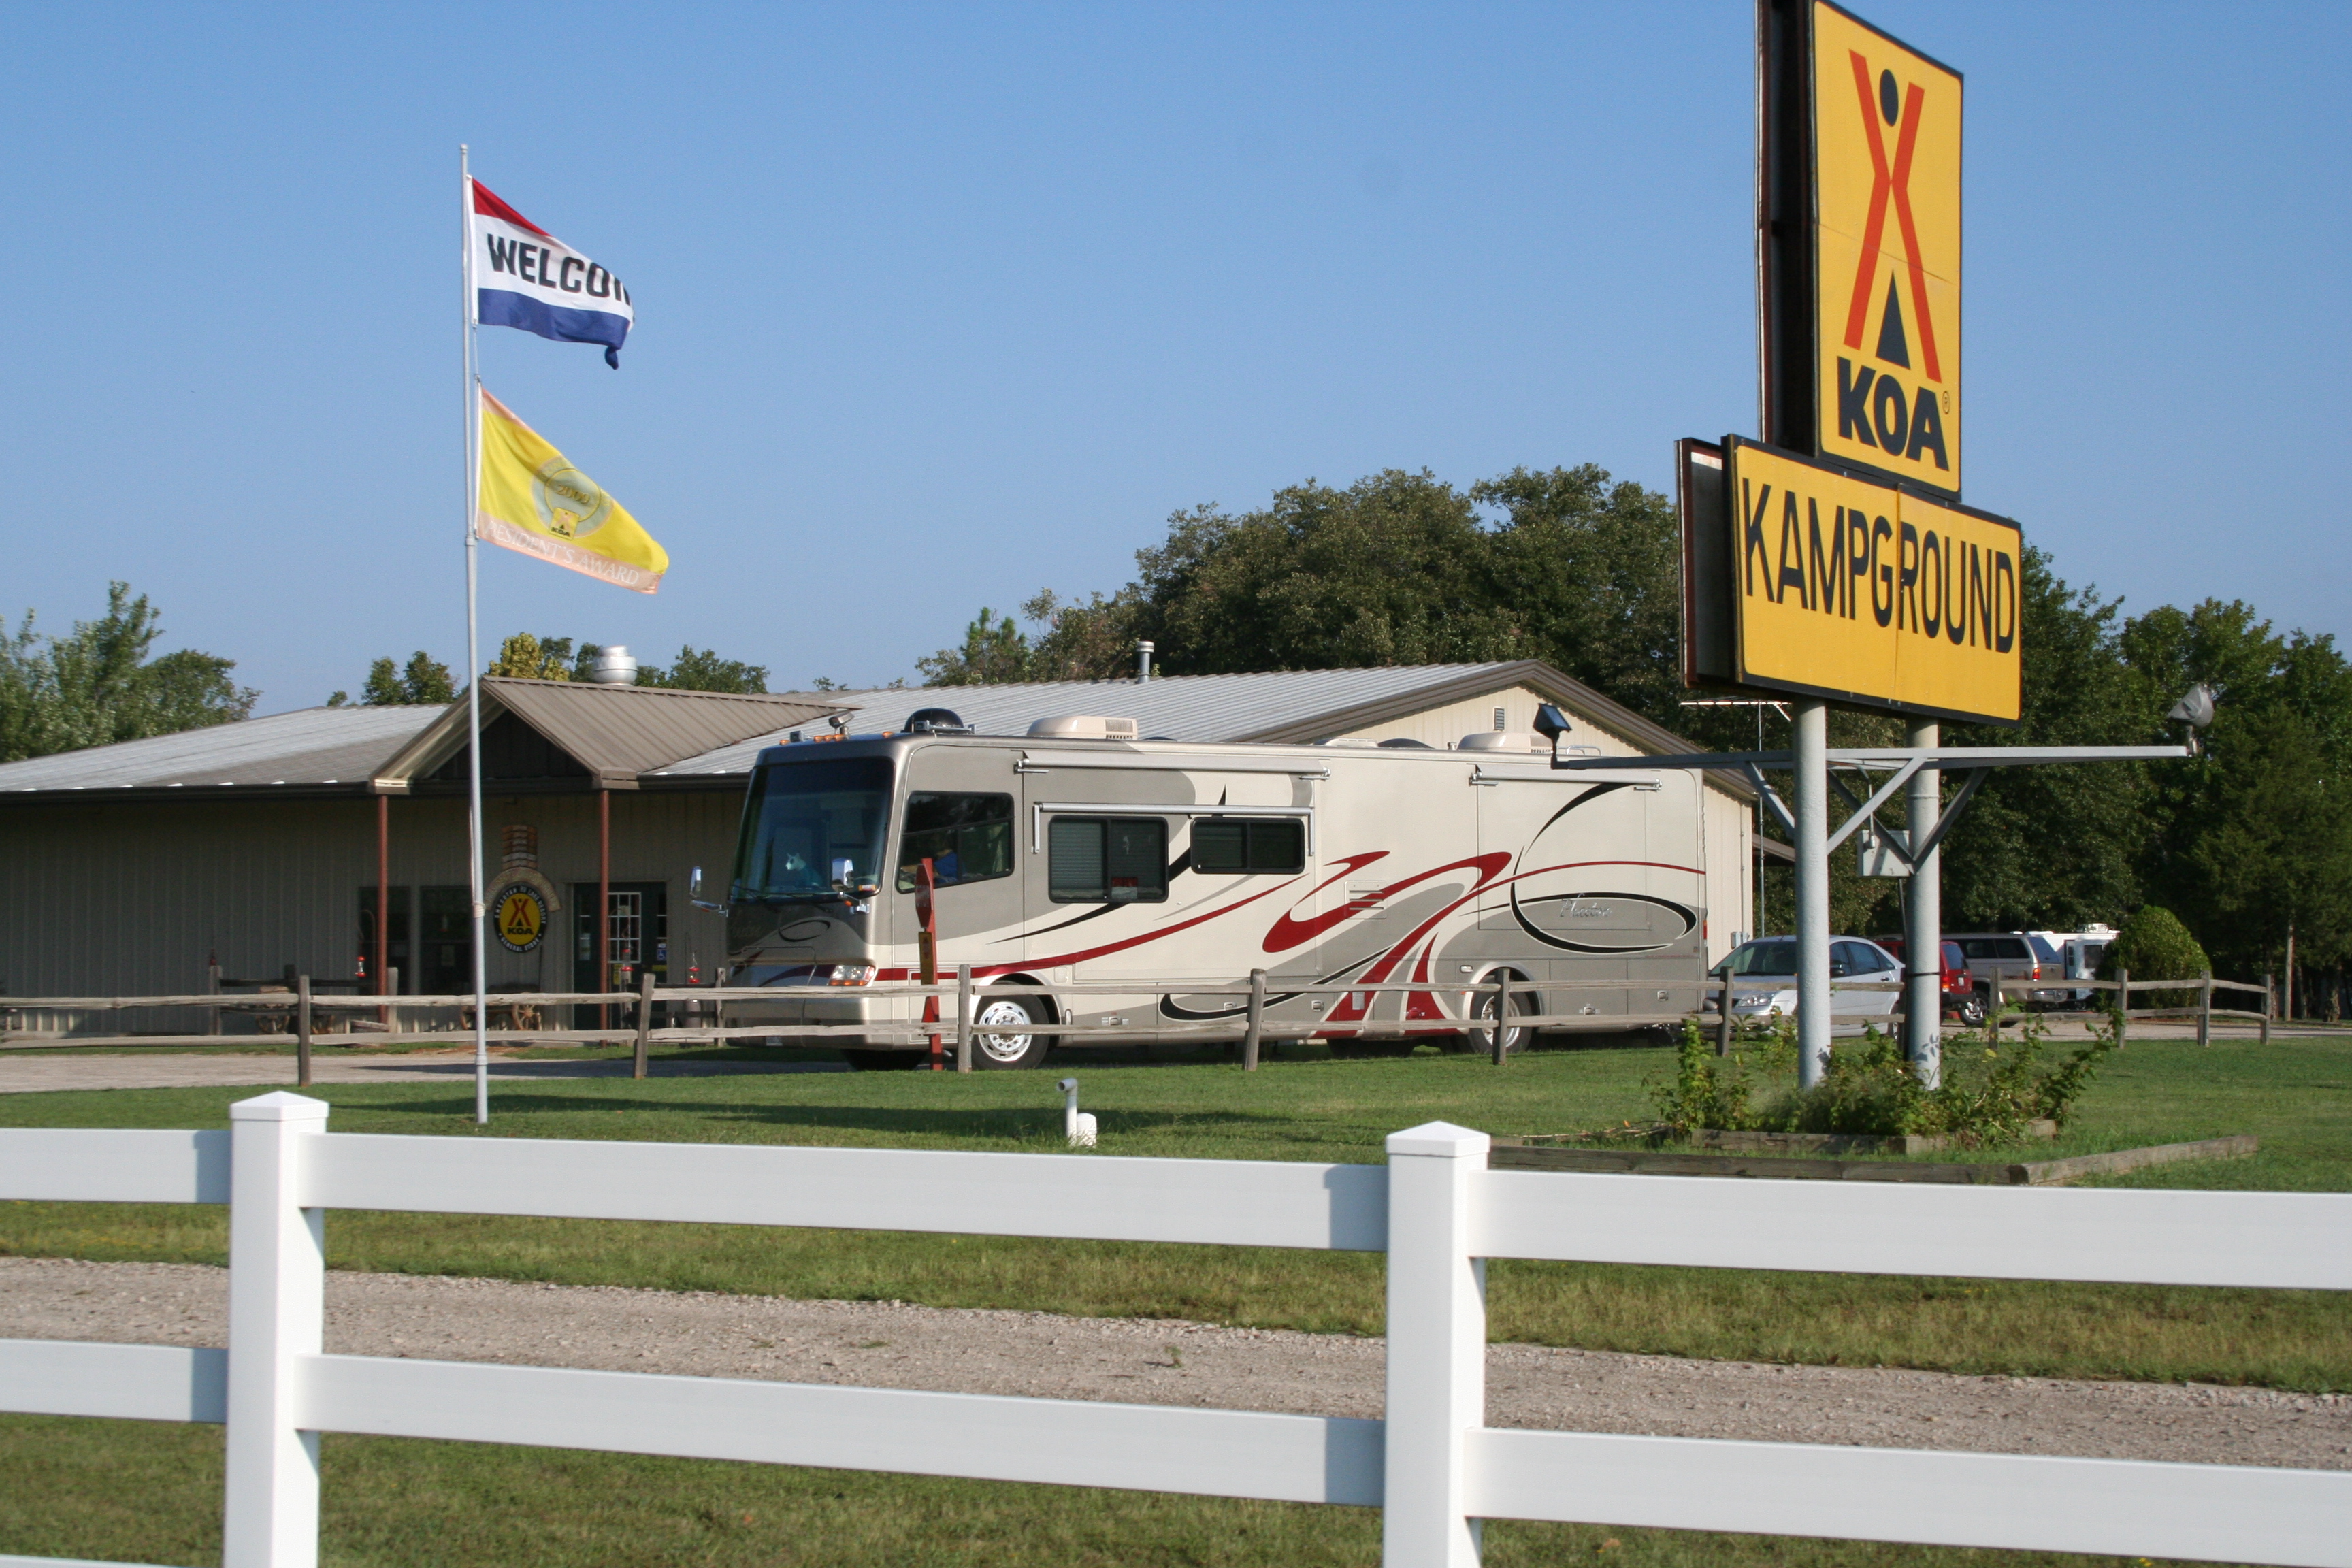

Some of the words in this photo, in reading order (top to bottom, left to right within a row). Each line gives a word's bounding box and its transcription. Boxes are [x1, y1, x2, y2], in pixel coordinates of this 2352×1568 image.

[1838, 355, 1949, 472] KOA
[551, 526, 571, 537] KOA
[1743, 476, 2015, 654] KAMPGROUND
[576, 554, 640, 585] AWARD
